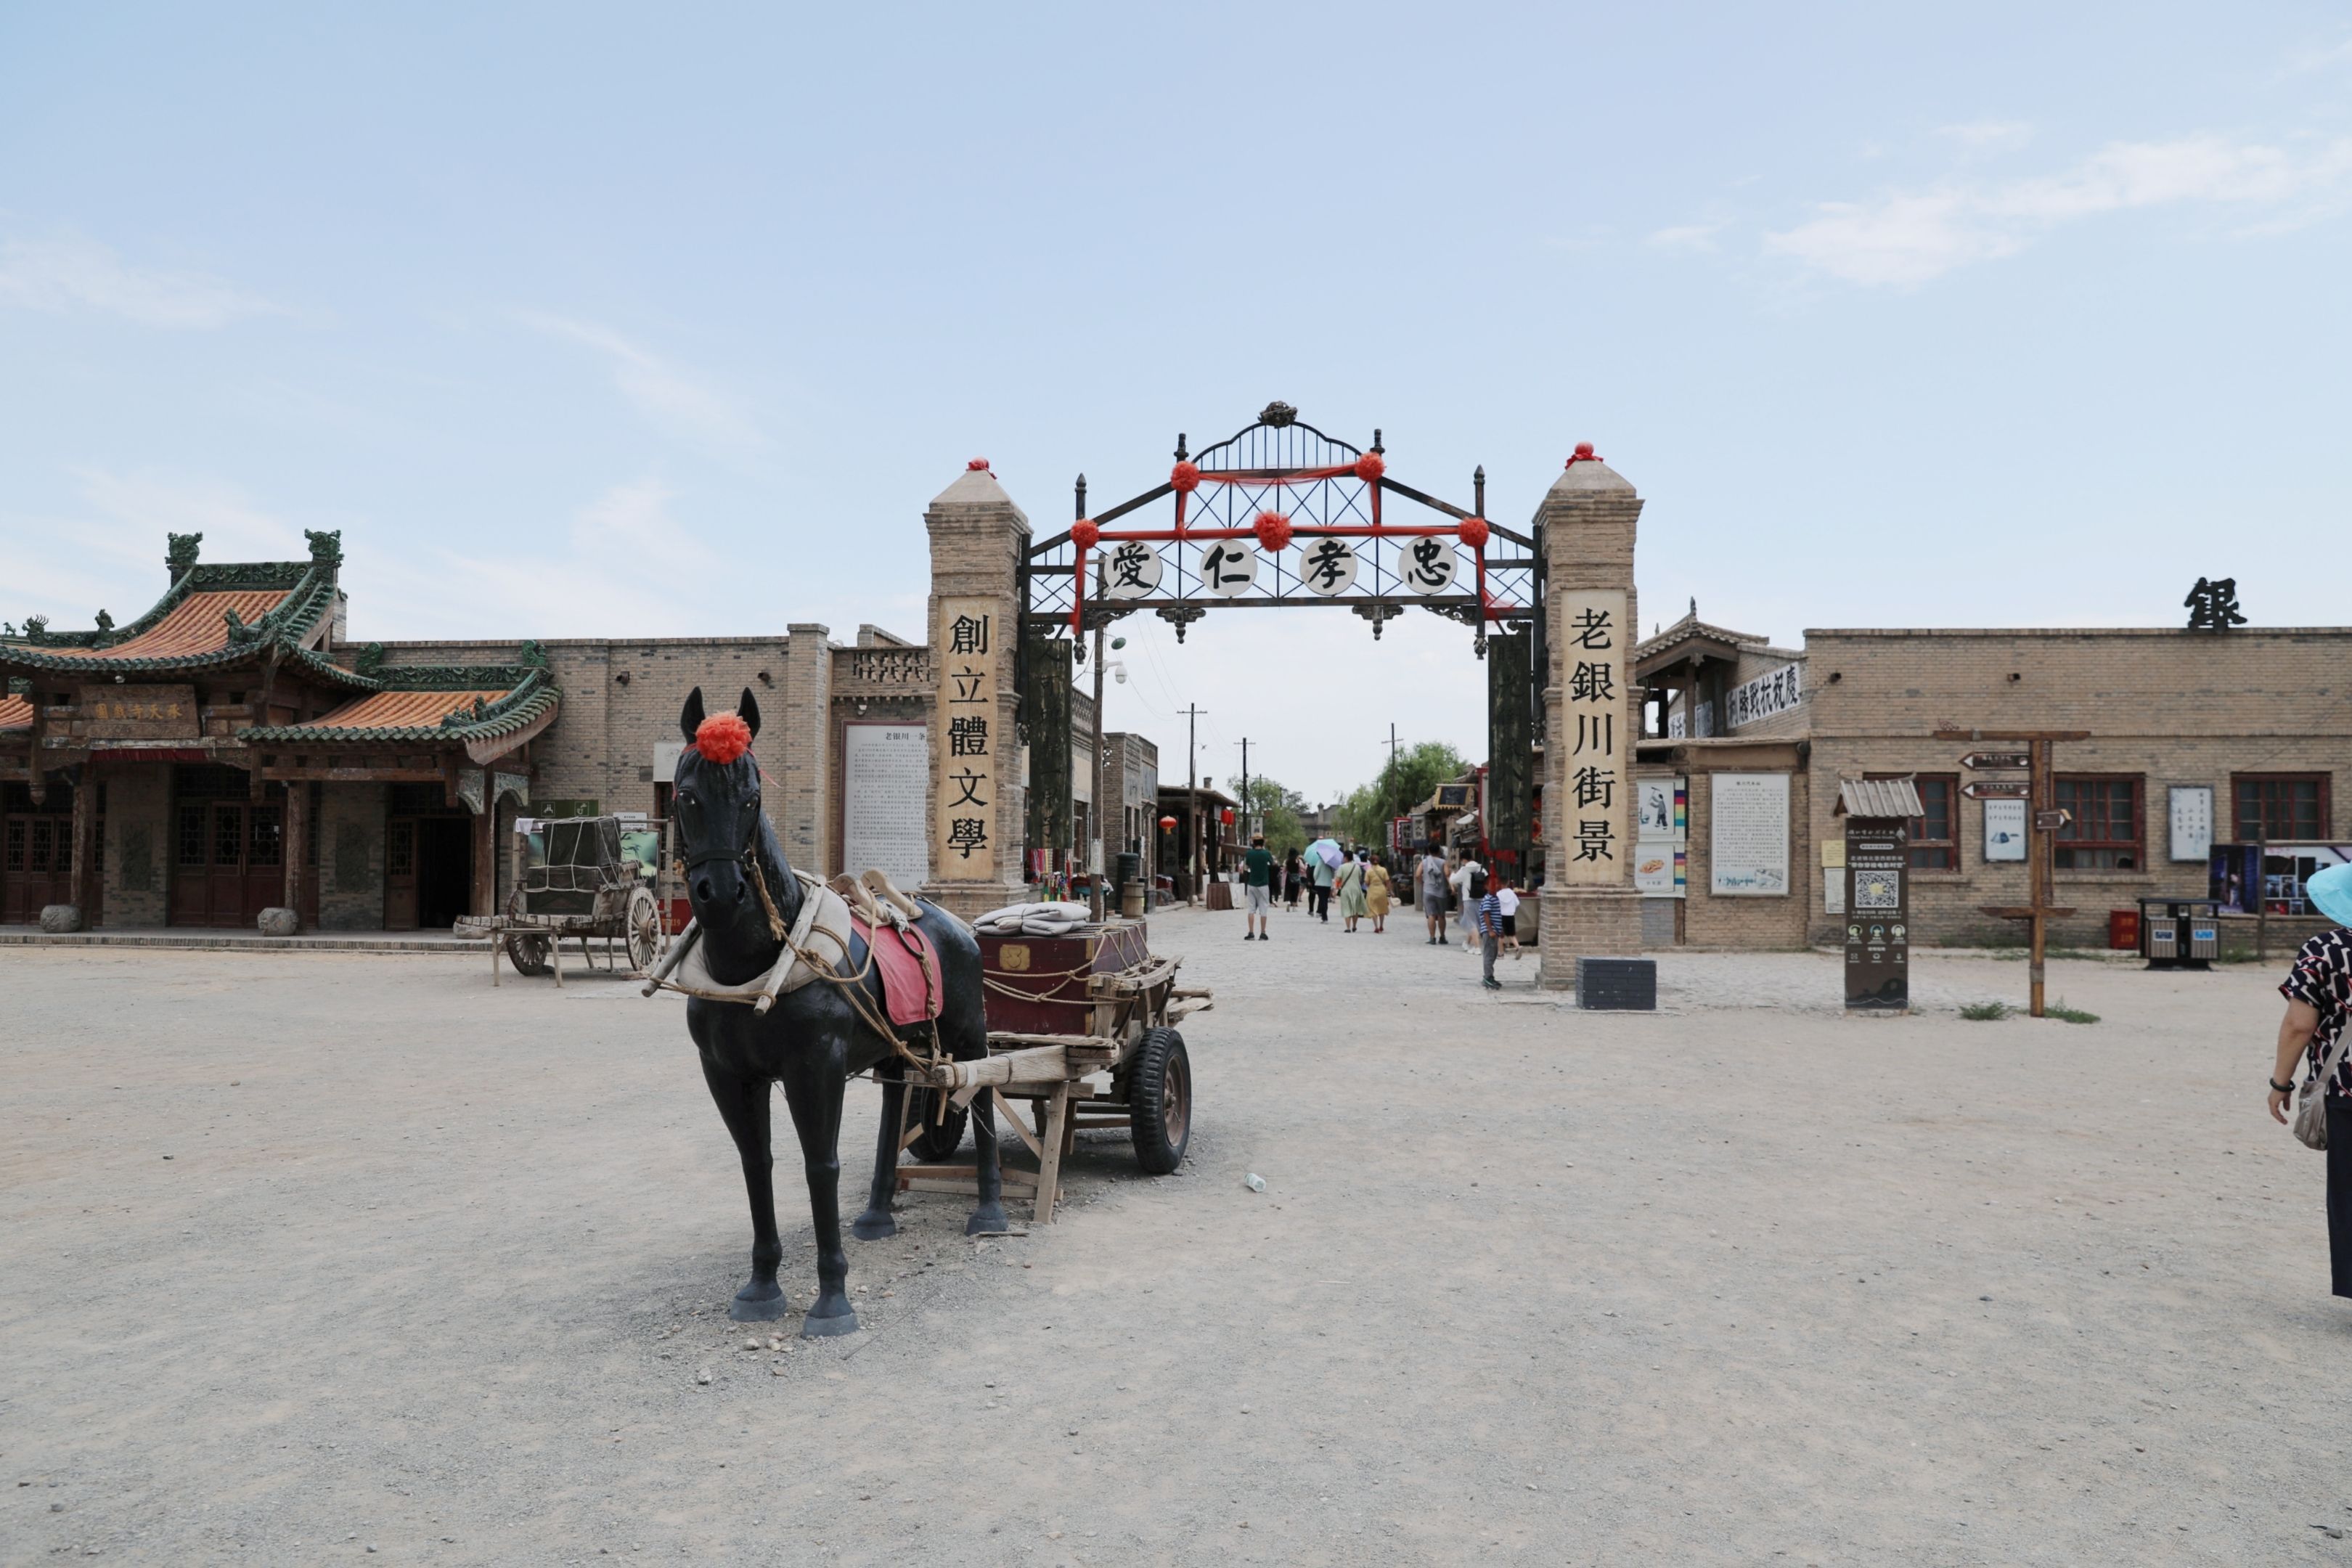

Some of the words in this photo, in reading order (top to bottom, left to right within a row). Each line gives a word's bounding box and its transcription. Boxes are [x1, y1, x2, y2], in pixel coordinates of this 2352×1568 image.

[2184, 577, 2247, 633] 銀
[947, 614, 989, 859] 創立體文學
[1569, 608, 1617, 862] 老銀川街景
